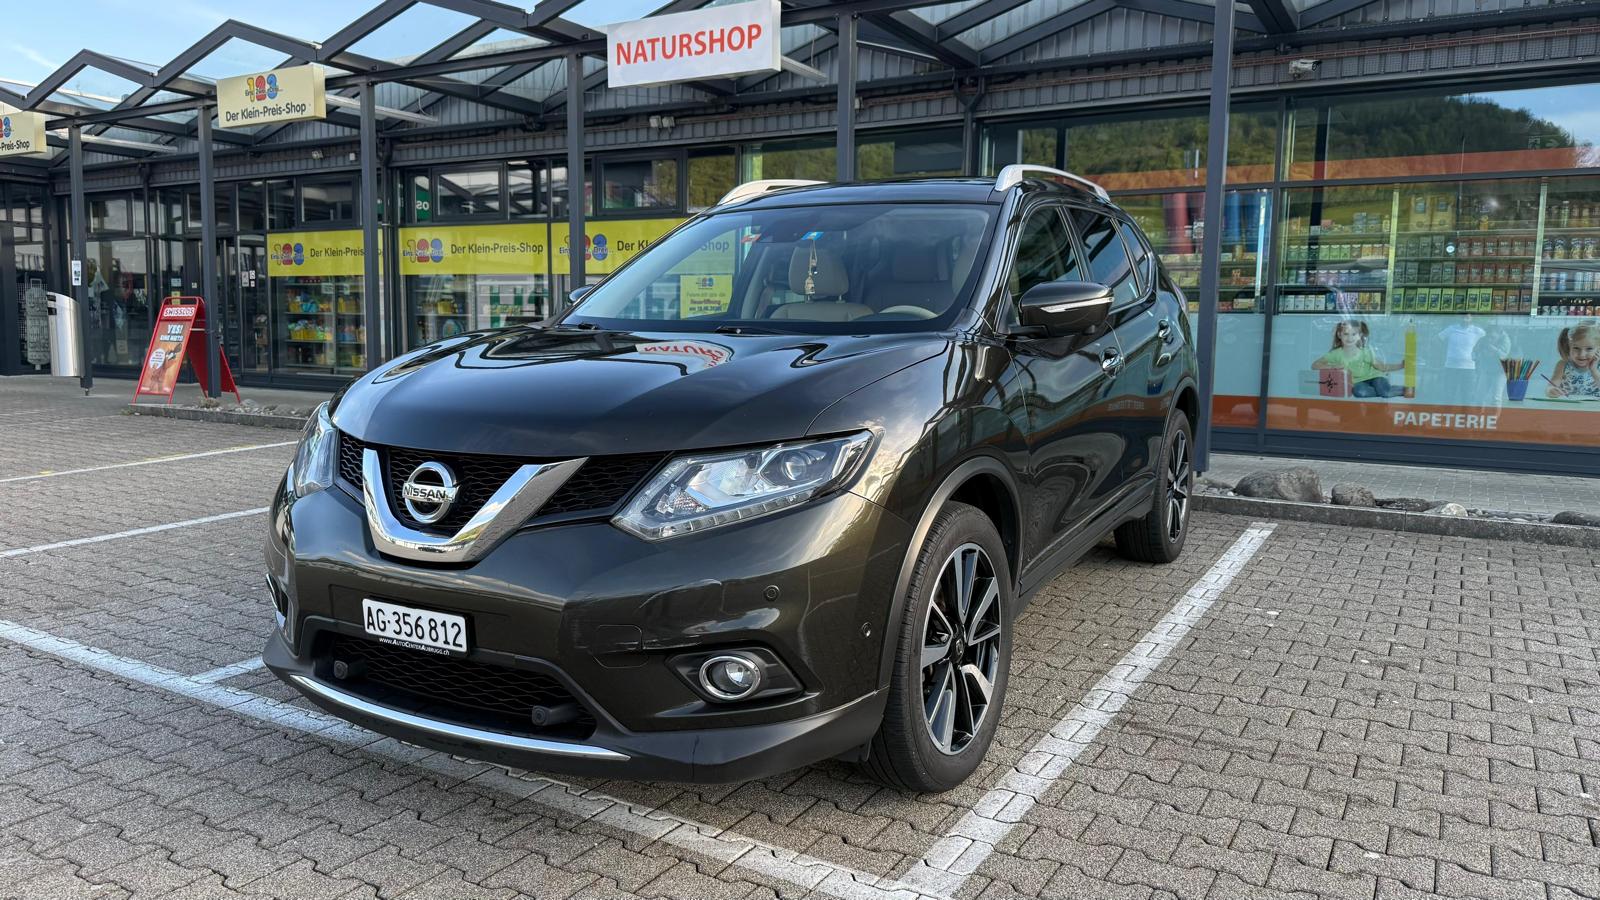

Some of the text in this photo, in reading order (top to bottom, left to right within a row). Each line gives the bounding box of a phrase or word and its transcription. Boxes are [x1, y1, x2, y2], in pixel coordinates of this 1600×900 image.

[616, 23, 762, 66] NATURSHOP
[225, 101, 307, 122] Der Klein-Preis-Shop
[0, 139, 30, 151] -Preis-Shop
[450, 242, 544, 255] Der Klein-Preis-Shop
[617, 240, 634, 251] Der
[310, 247, 323, 258] Der
[164, 307, 195, 317] SWISSLOS
[1393, 410, 1498, 430] PAPETERIE
[403, 485, 447, 499] NISSAN
